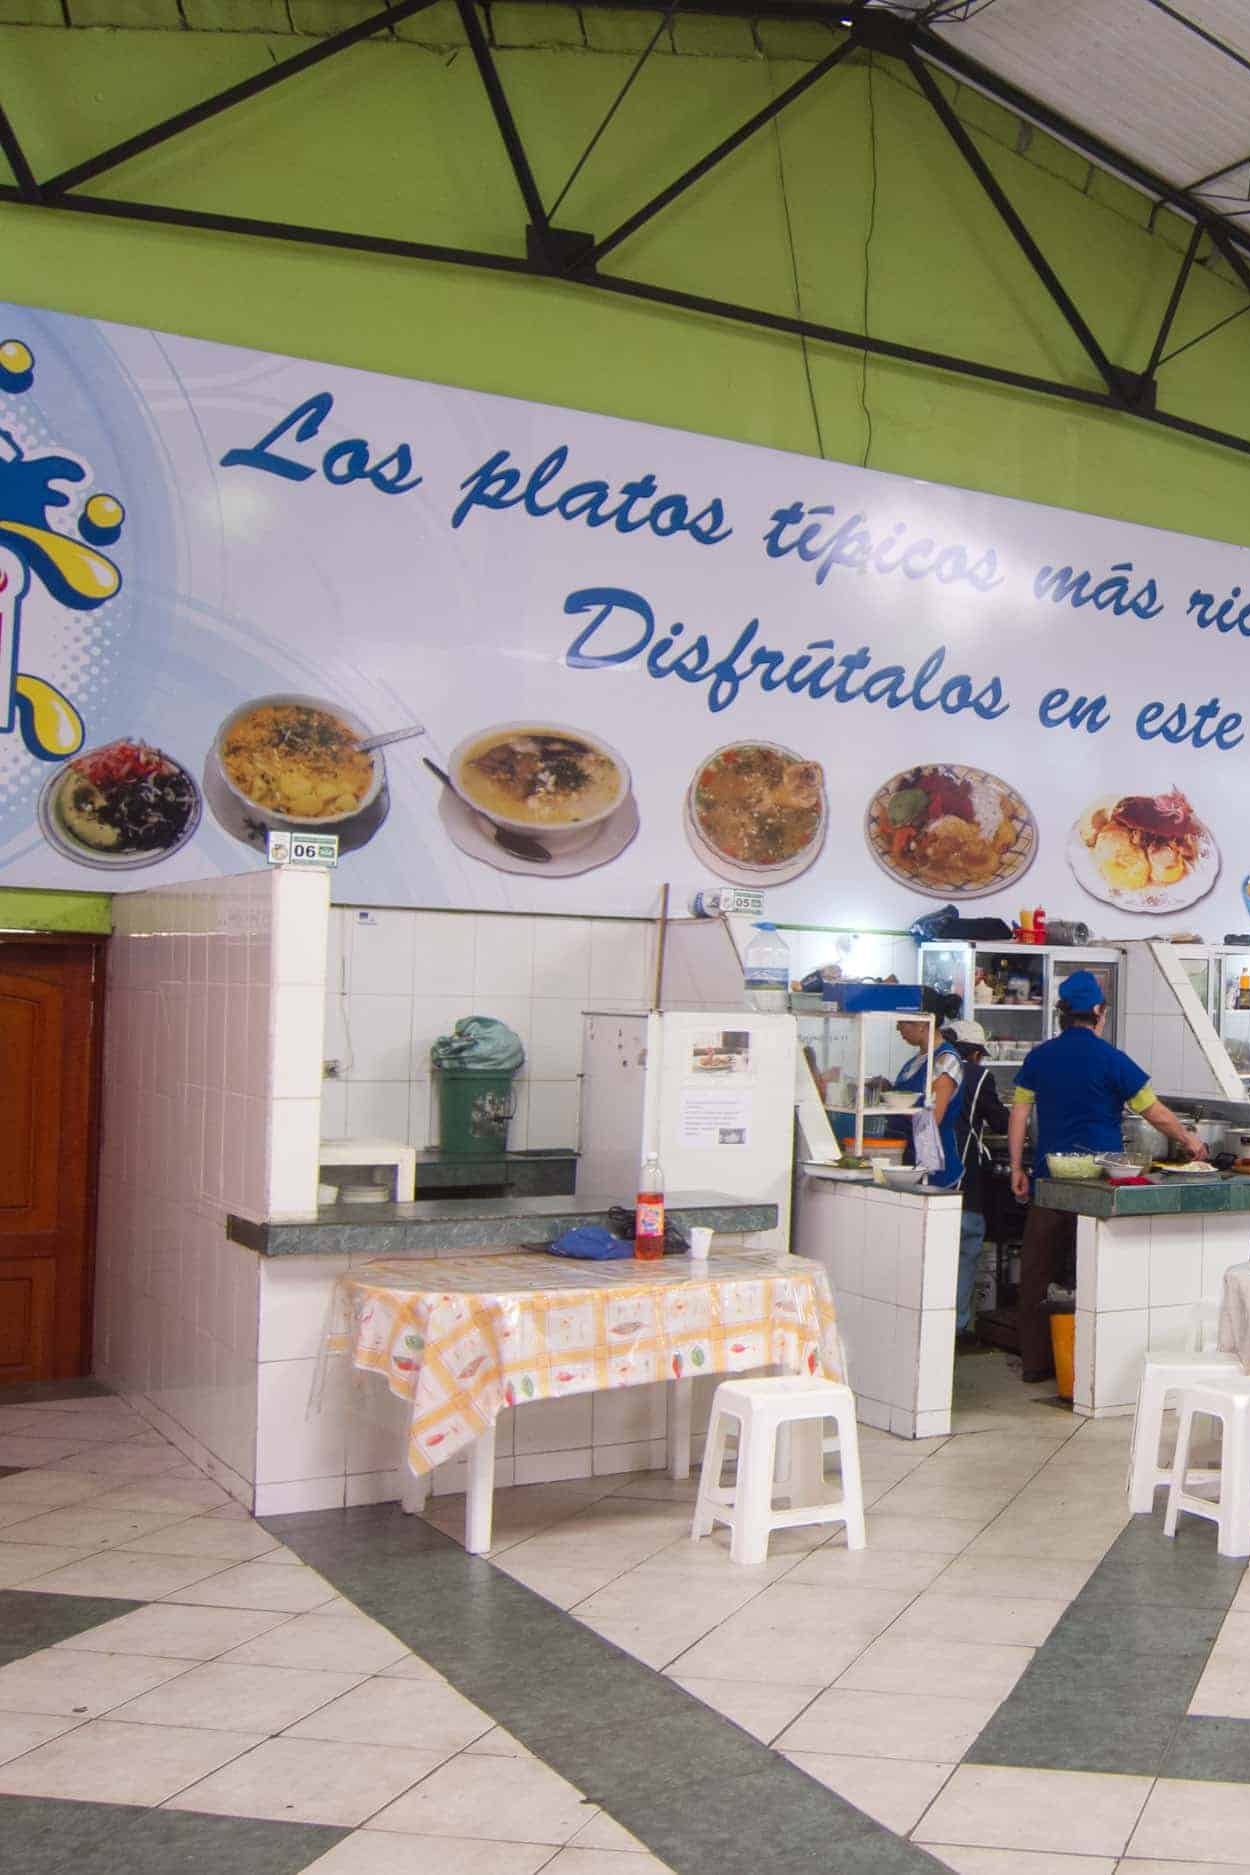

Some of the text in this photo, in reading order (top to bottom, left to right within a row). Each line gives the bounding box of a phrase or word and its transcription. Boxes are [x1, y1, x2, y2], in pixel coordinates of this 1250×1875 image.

[220, 393, 422, 494] Los
[453, 446, 733, 544] platos
[763, 501, 1006, 592] típicos
[1034, 562, 1163, 620] más
[564, 588, 1009, 719] Disfrútalos
[1039, 688, 1110, 735] en
[1136, 698, 1243, 751] este
[293, 844, 316, 857] 06
[735, 898, 750, 908] 05
